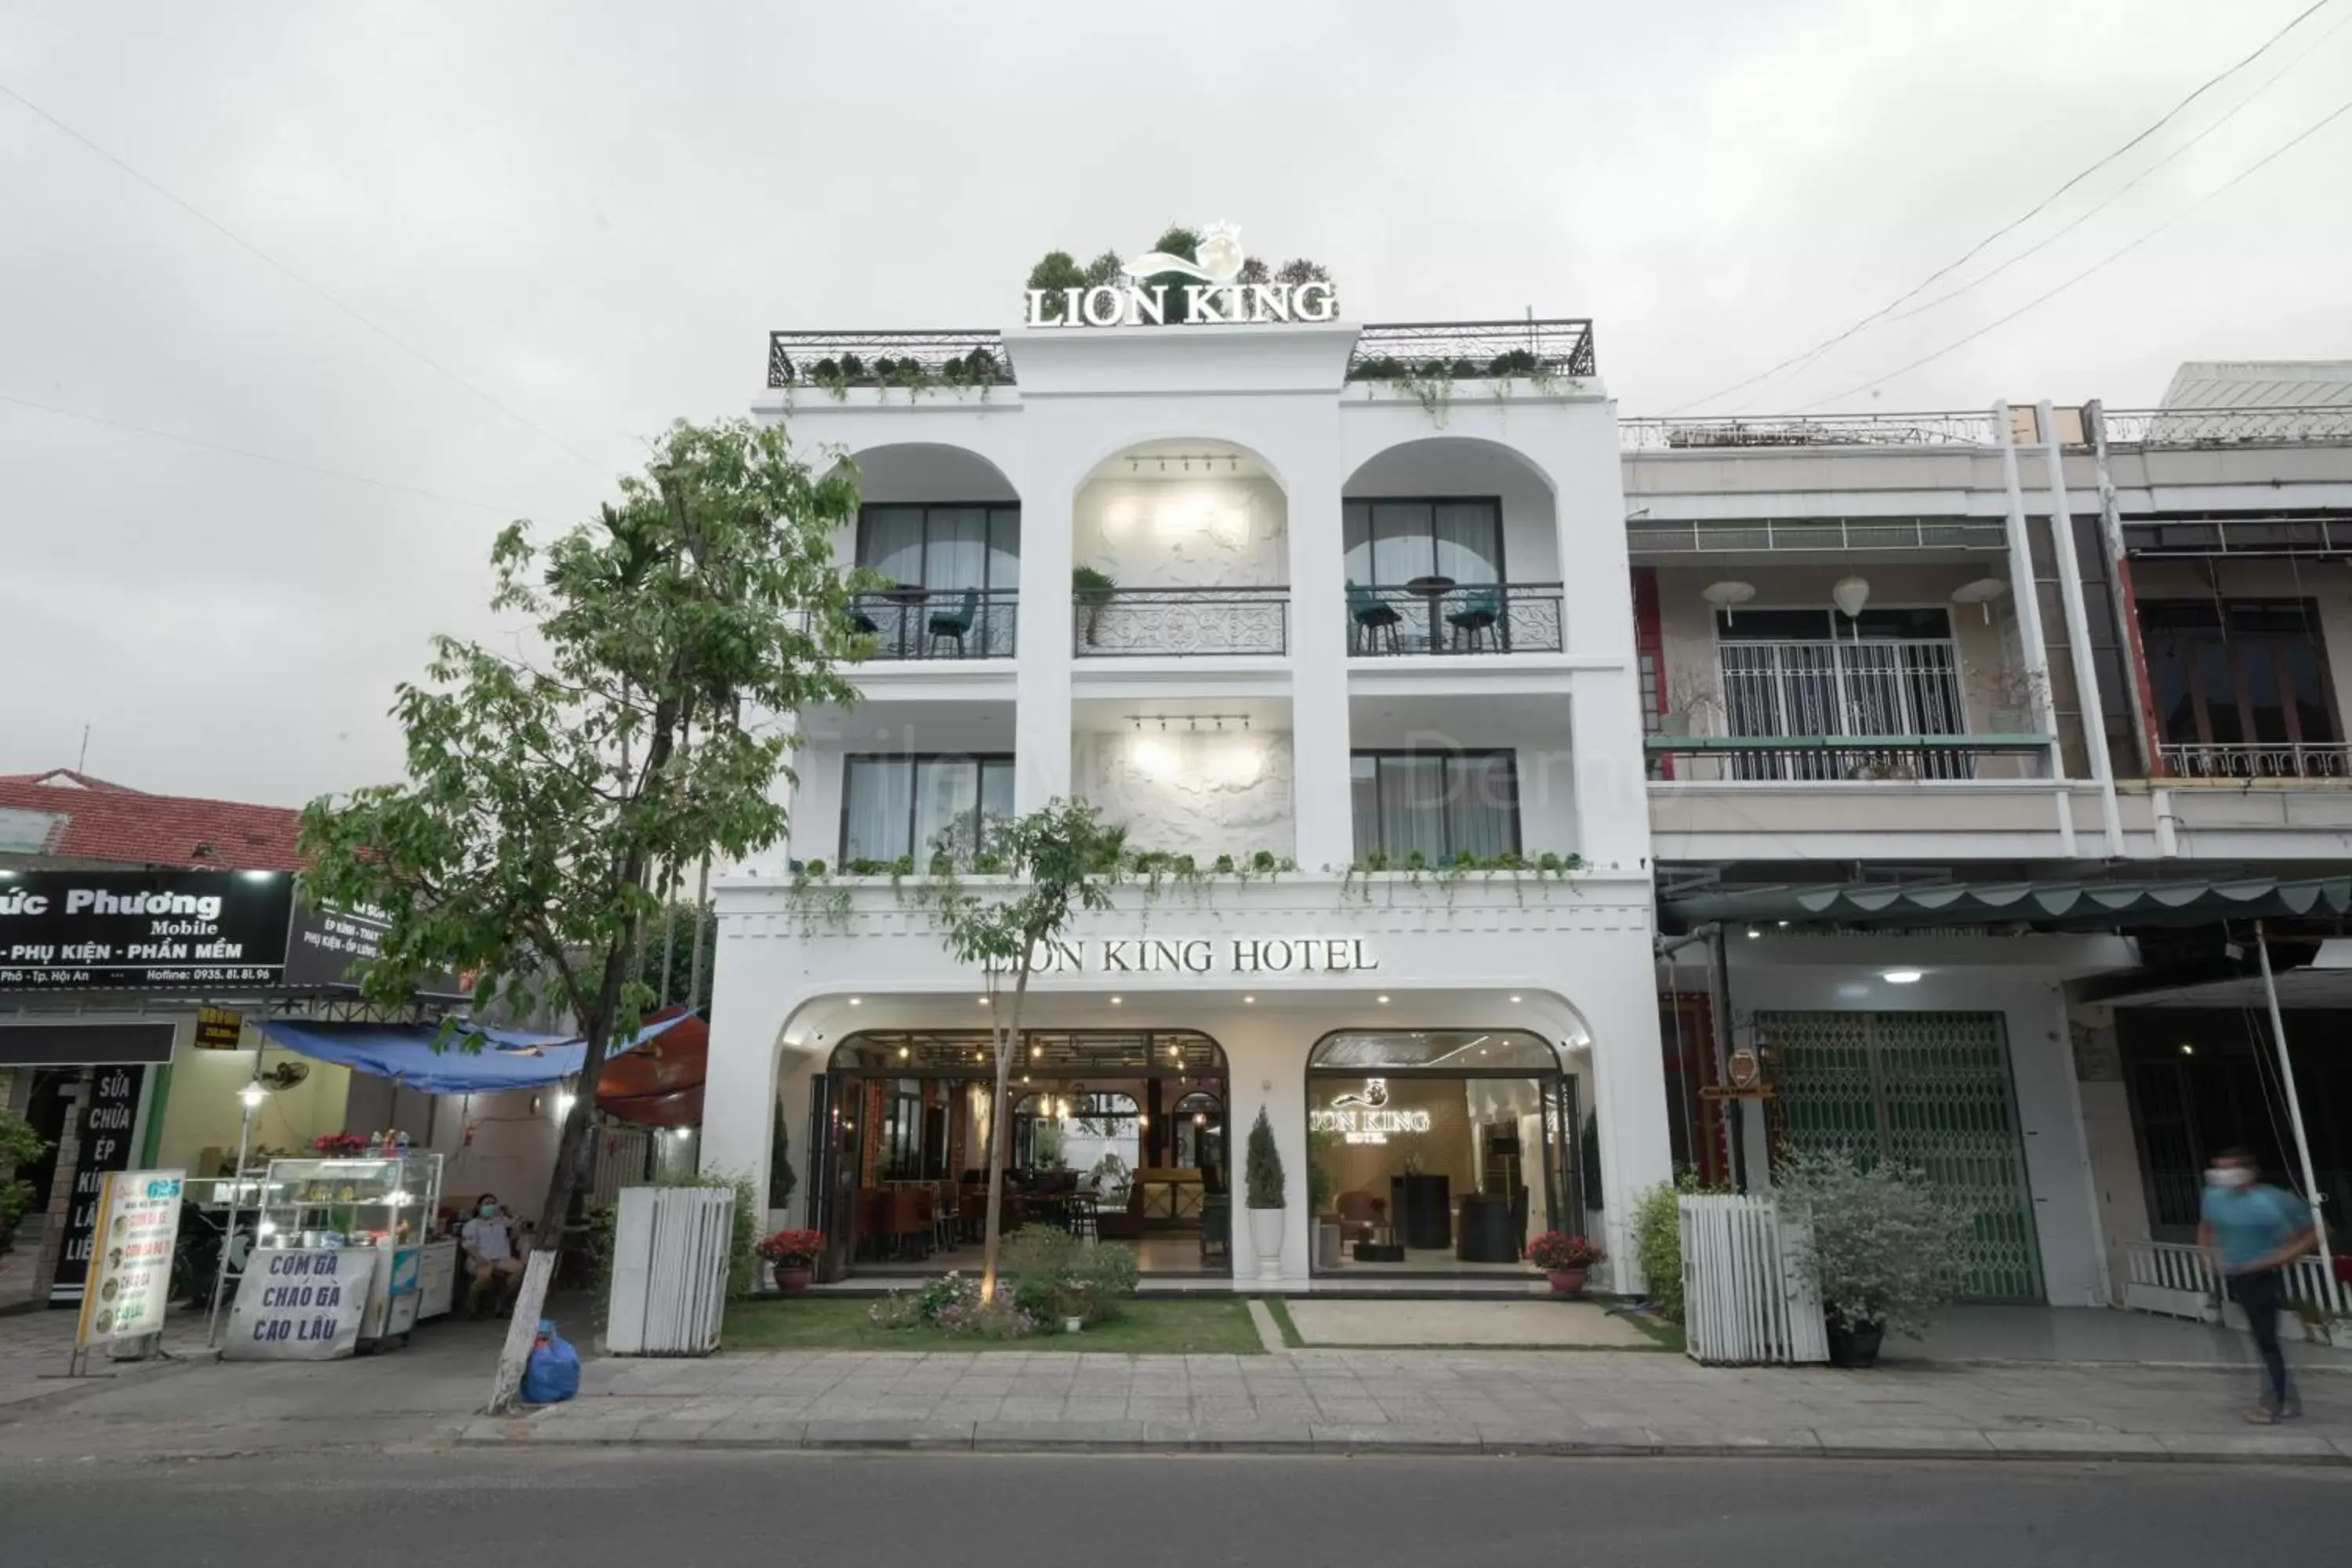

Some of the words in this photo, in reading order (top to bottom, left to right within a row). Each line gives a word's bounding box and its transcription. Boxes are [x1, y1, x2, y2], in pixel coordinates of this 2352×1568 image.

[1026, 285, 1169, 327] LION
[1183, 281, 1337, 324] KING
[66, 889, 222, 920] Phương
[151, 920, 219, 935] Mobile
[11, 945, 56, 964] PHỤ
[61, 940, 111, 964] KIỆN
[128, 937, 187, 959] PHẦN
[1102, 940, 1214, 973] KING
[1231, 938, 1379, 972] HOTEL
[100, 1069, 130, 1097] SỬA
[89, 1102, 129, 1128] CHỮA
[1310, 1111, 1356, 1131] ION
[1363, 1110, 1431, 1131] KING
[94, 1135, 115, 1160] ÉP
[269, 1254, 310, 1275] CƠM
[313, 1250, 338, 1275] GÀ
[315, 1279, 341, 1307] GÀ
[253, 1319, 291, 1341] CAO
[297, 1312, 338, 1340] LẦU
